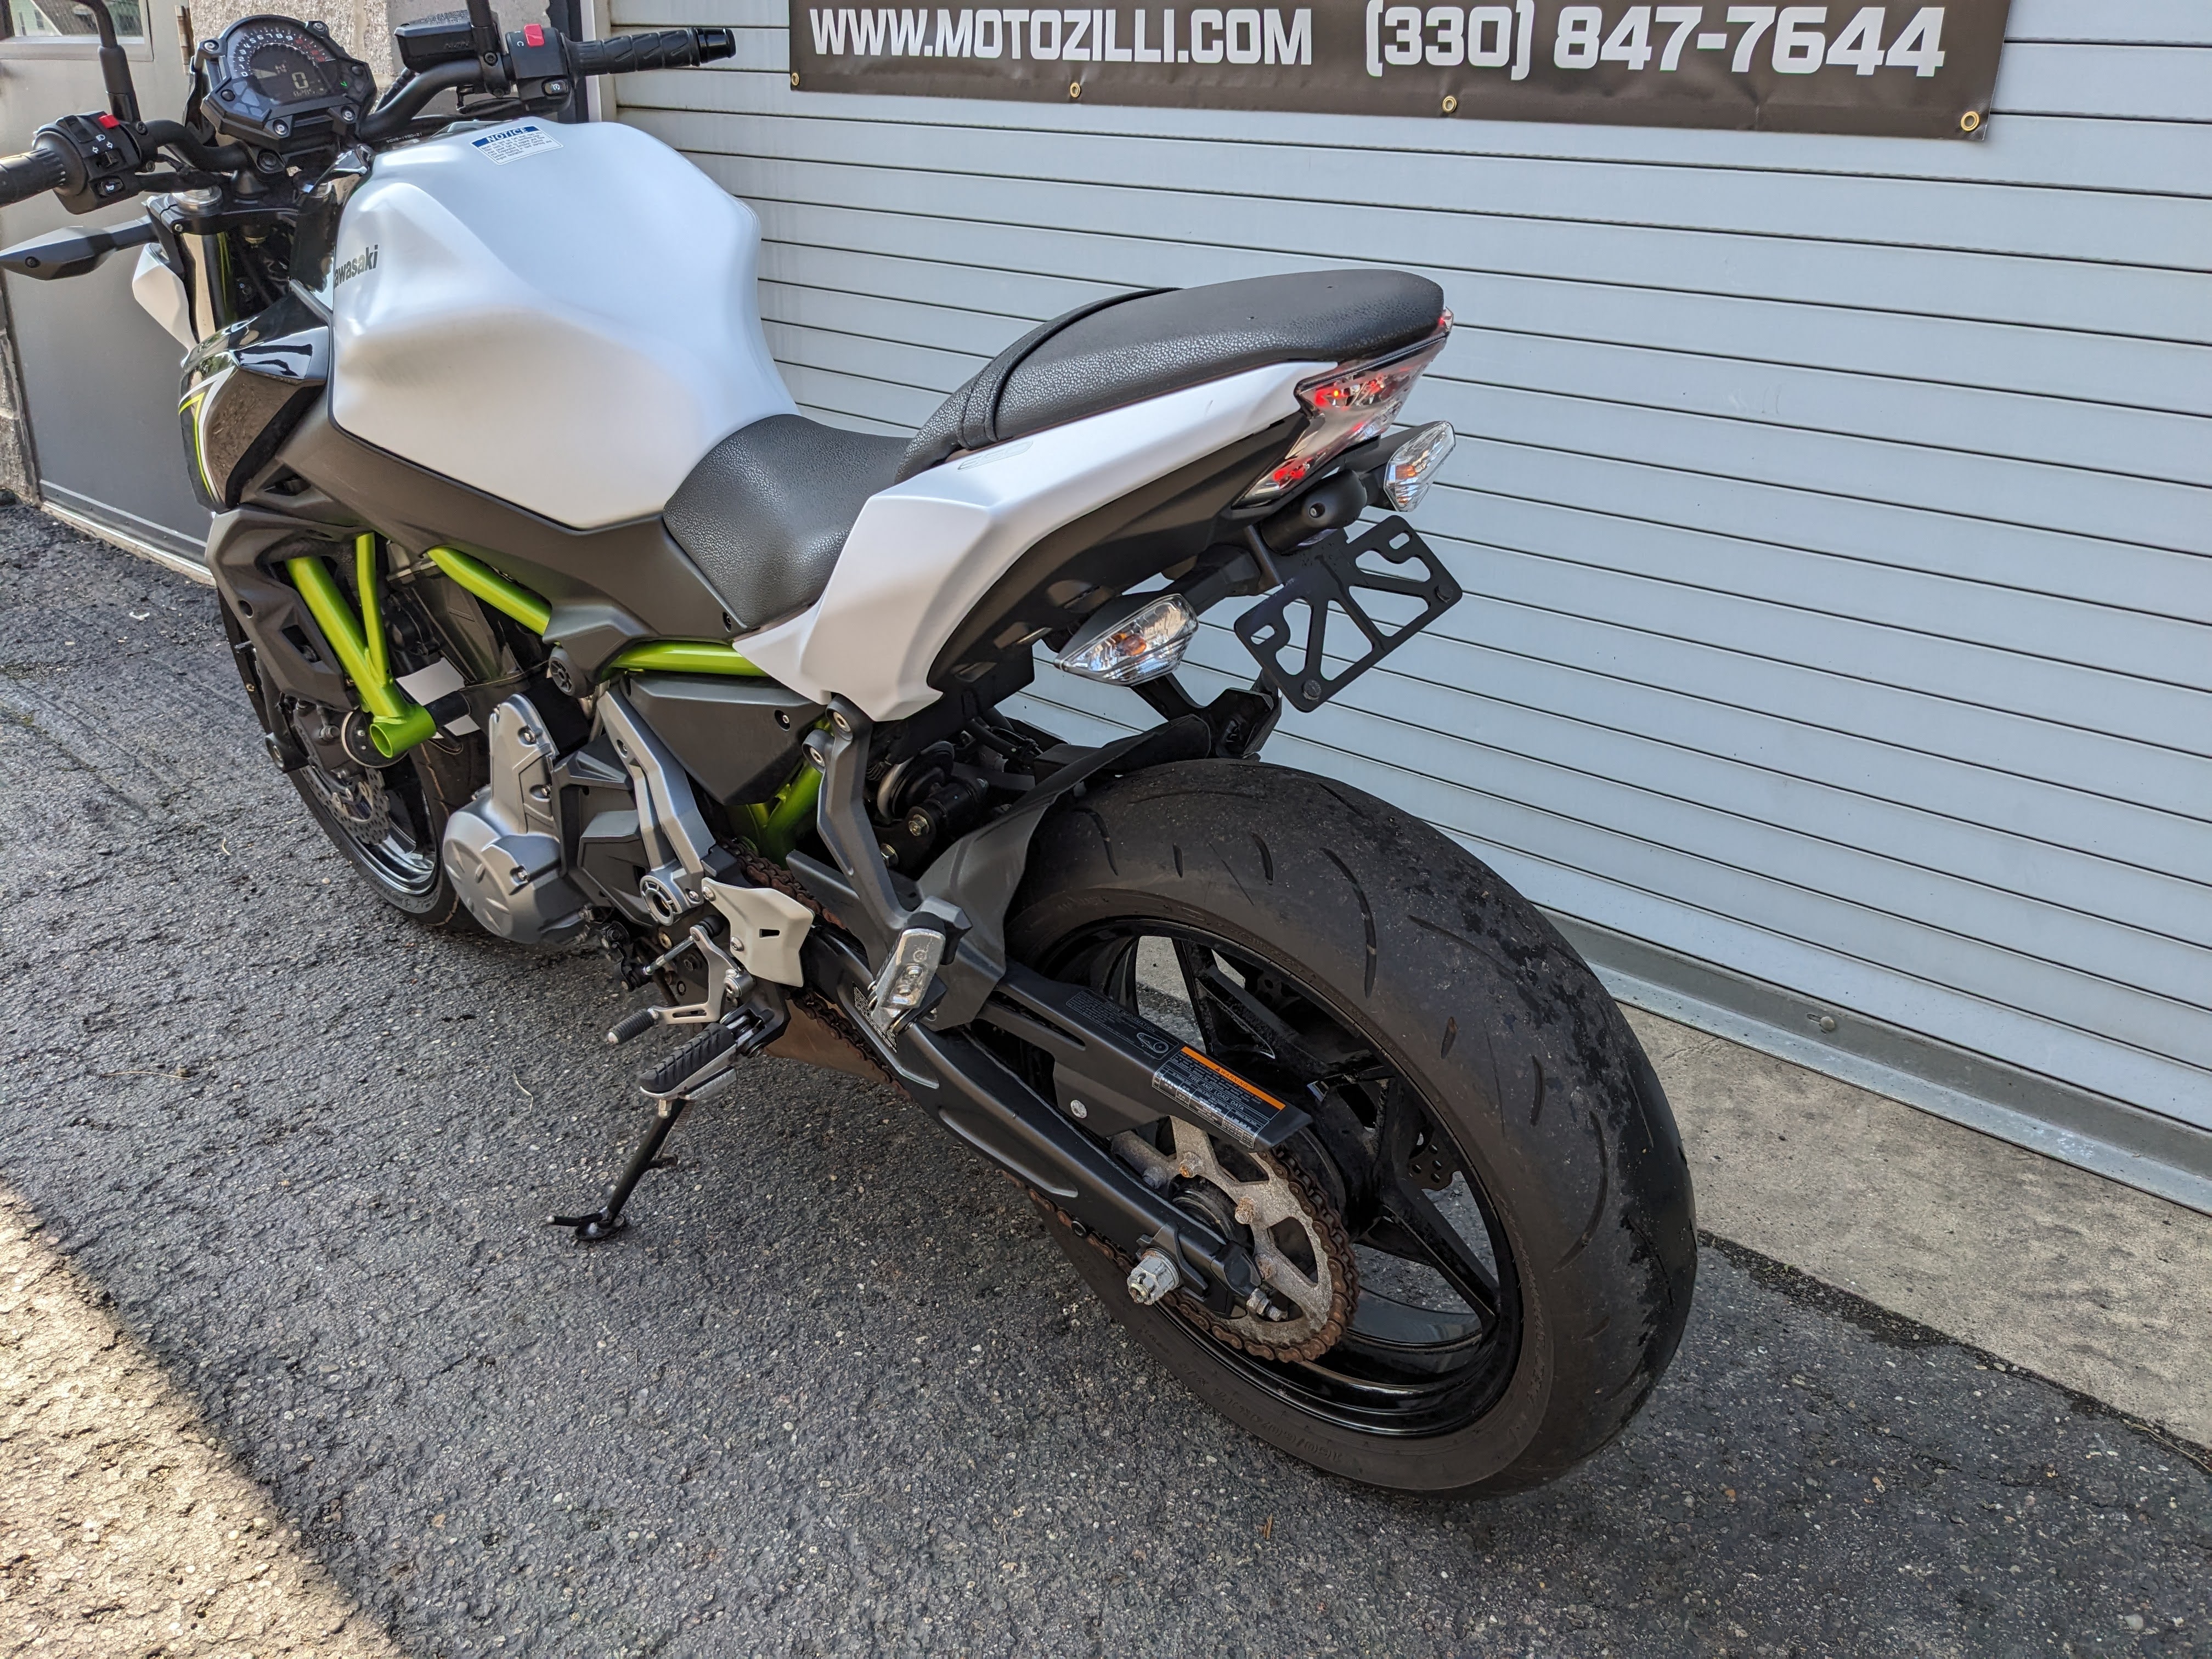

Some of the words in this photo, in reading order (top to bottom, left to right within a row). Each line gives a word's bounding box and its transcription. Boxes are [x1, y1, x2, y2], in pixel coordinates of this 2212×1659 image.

[809, 8, 1312, 65] WWW.MOTOZILLI.COM
[1366, 0, 1534, 81] (330)
[1553, 5, 1945, 76] 847-7644
[291, 72, 309, 89] 0
[486, 127, 528, 143] NOTICE
[334, 244, 379, 290] awasaki
[1188, 1074, 1201, 1084] TIRE
[1200, 1082, 1213, 1092] AND
[1214, 1090, 1229, 1102] LOAD
[1230, 1100, 1245, 1111] DATA
[1220, 1070, 1248, 1088] WARNING
